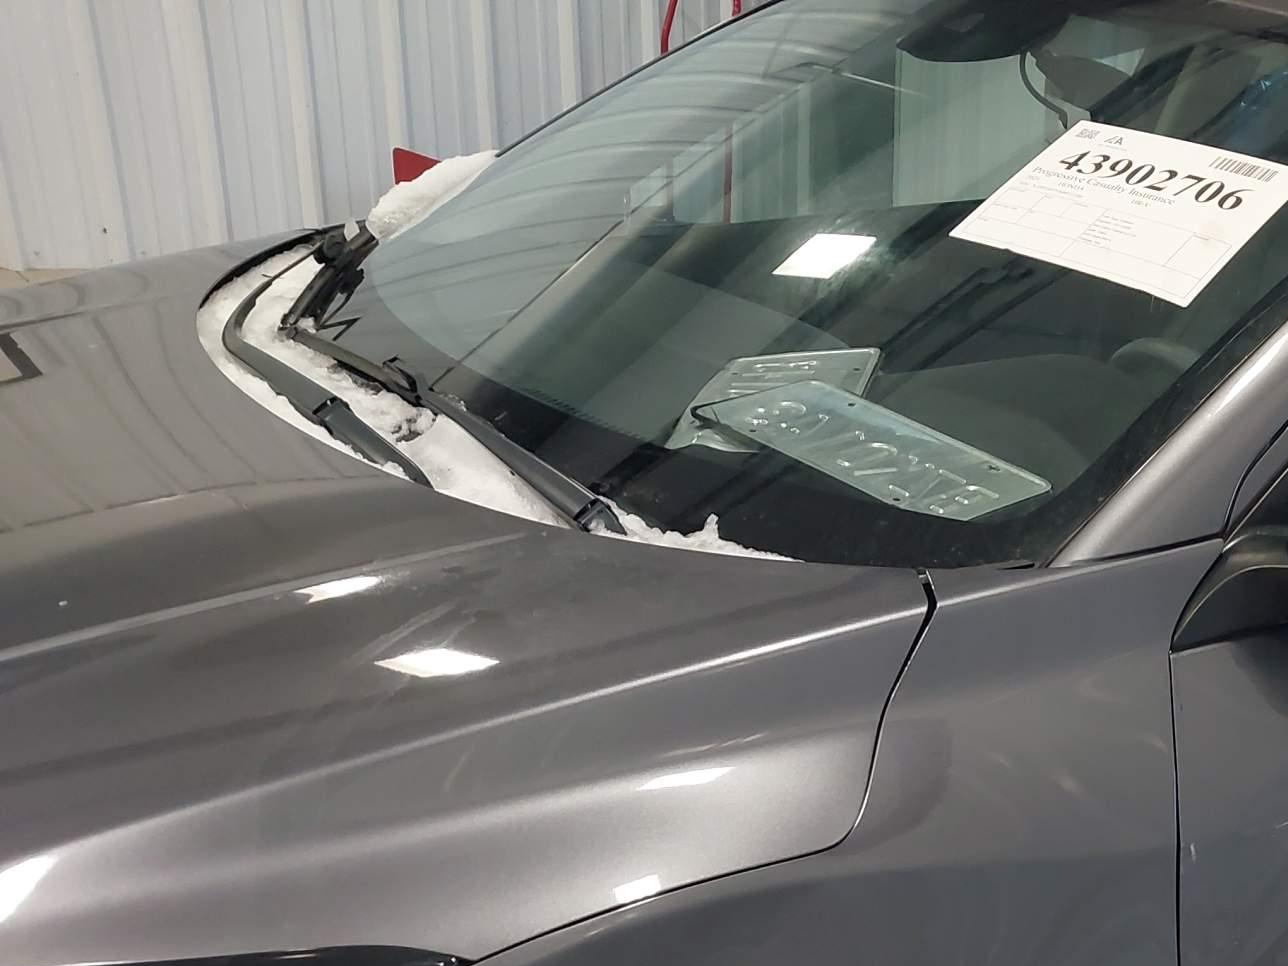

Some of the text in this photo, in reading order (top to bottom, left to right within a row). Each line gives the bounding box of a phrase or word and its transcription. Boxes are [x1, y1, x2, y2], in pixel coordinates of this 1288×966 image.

[1059, 150, 1255, 210] 43902706
[1086, 177, 1126, 194] Casualty
[1128, 187, 1176, 206] Insurance
